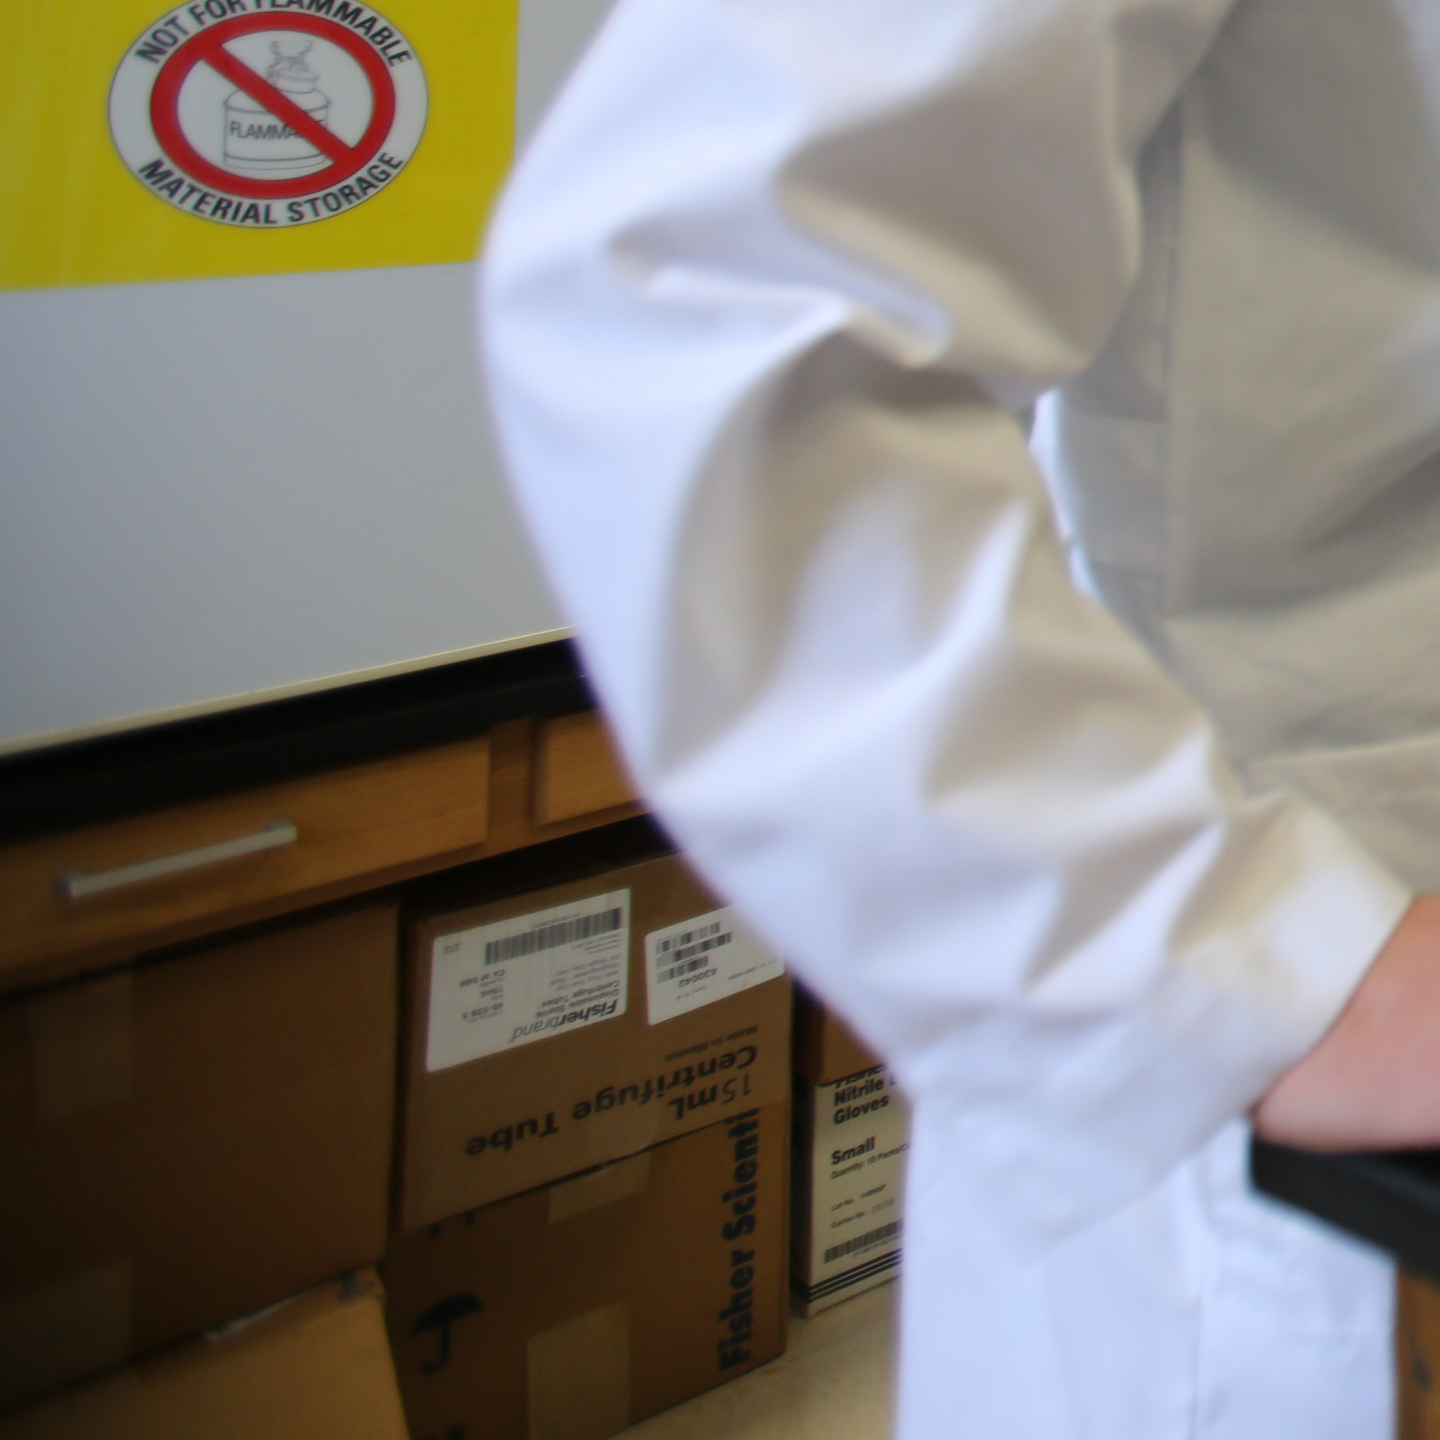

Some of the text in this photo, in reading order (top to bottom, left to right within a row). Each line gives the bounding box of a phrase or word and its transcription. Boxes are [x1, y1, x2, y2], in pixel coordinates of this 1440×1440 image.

[135, 16, 189, 65] NOT
[138, 152, 403, 225] MATERIAL STORAGE
[507, 997, 619, 1044] Fisherbrand
[665, 1025, 759, 1063] Made in Mexico
[465, 1045, 757, 1158] Centrifuge Tube
[667, 1072, 753, 1120] 15mL
[834, 1077, 884, 1107] Nitrile
[834, 1094, 889, 1125] Gloves
[831, 1136, 875, 1165] Small
[718, 1250, 755, 1371] Fisher
